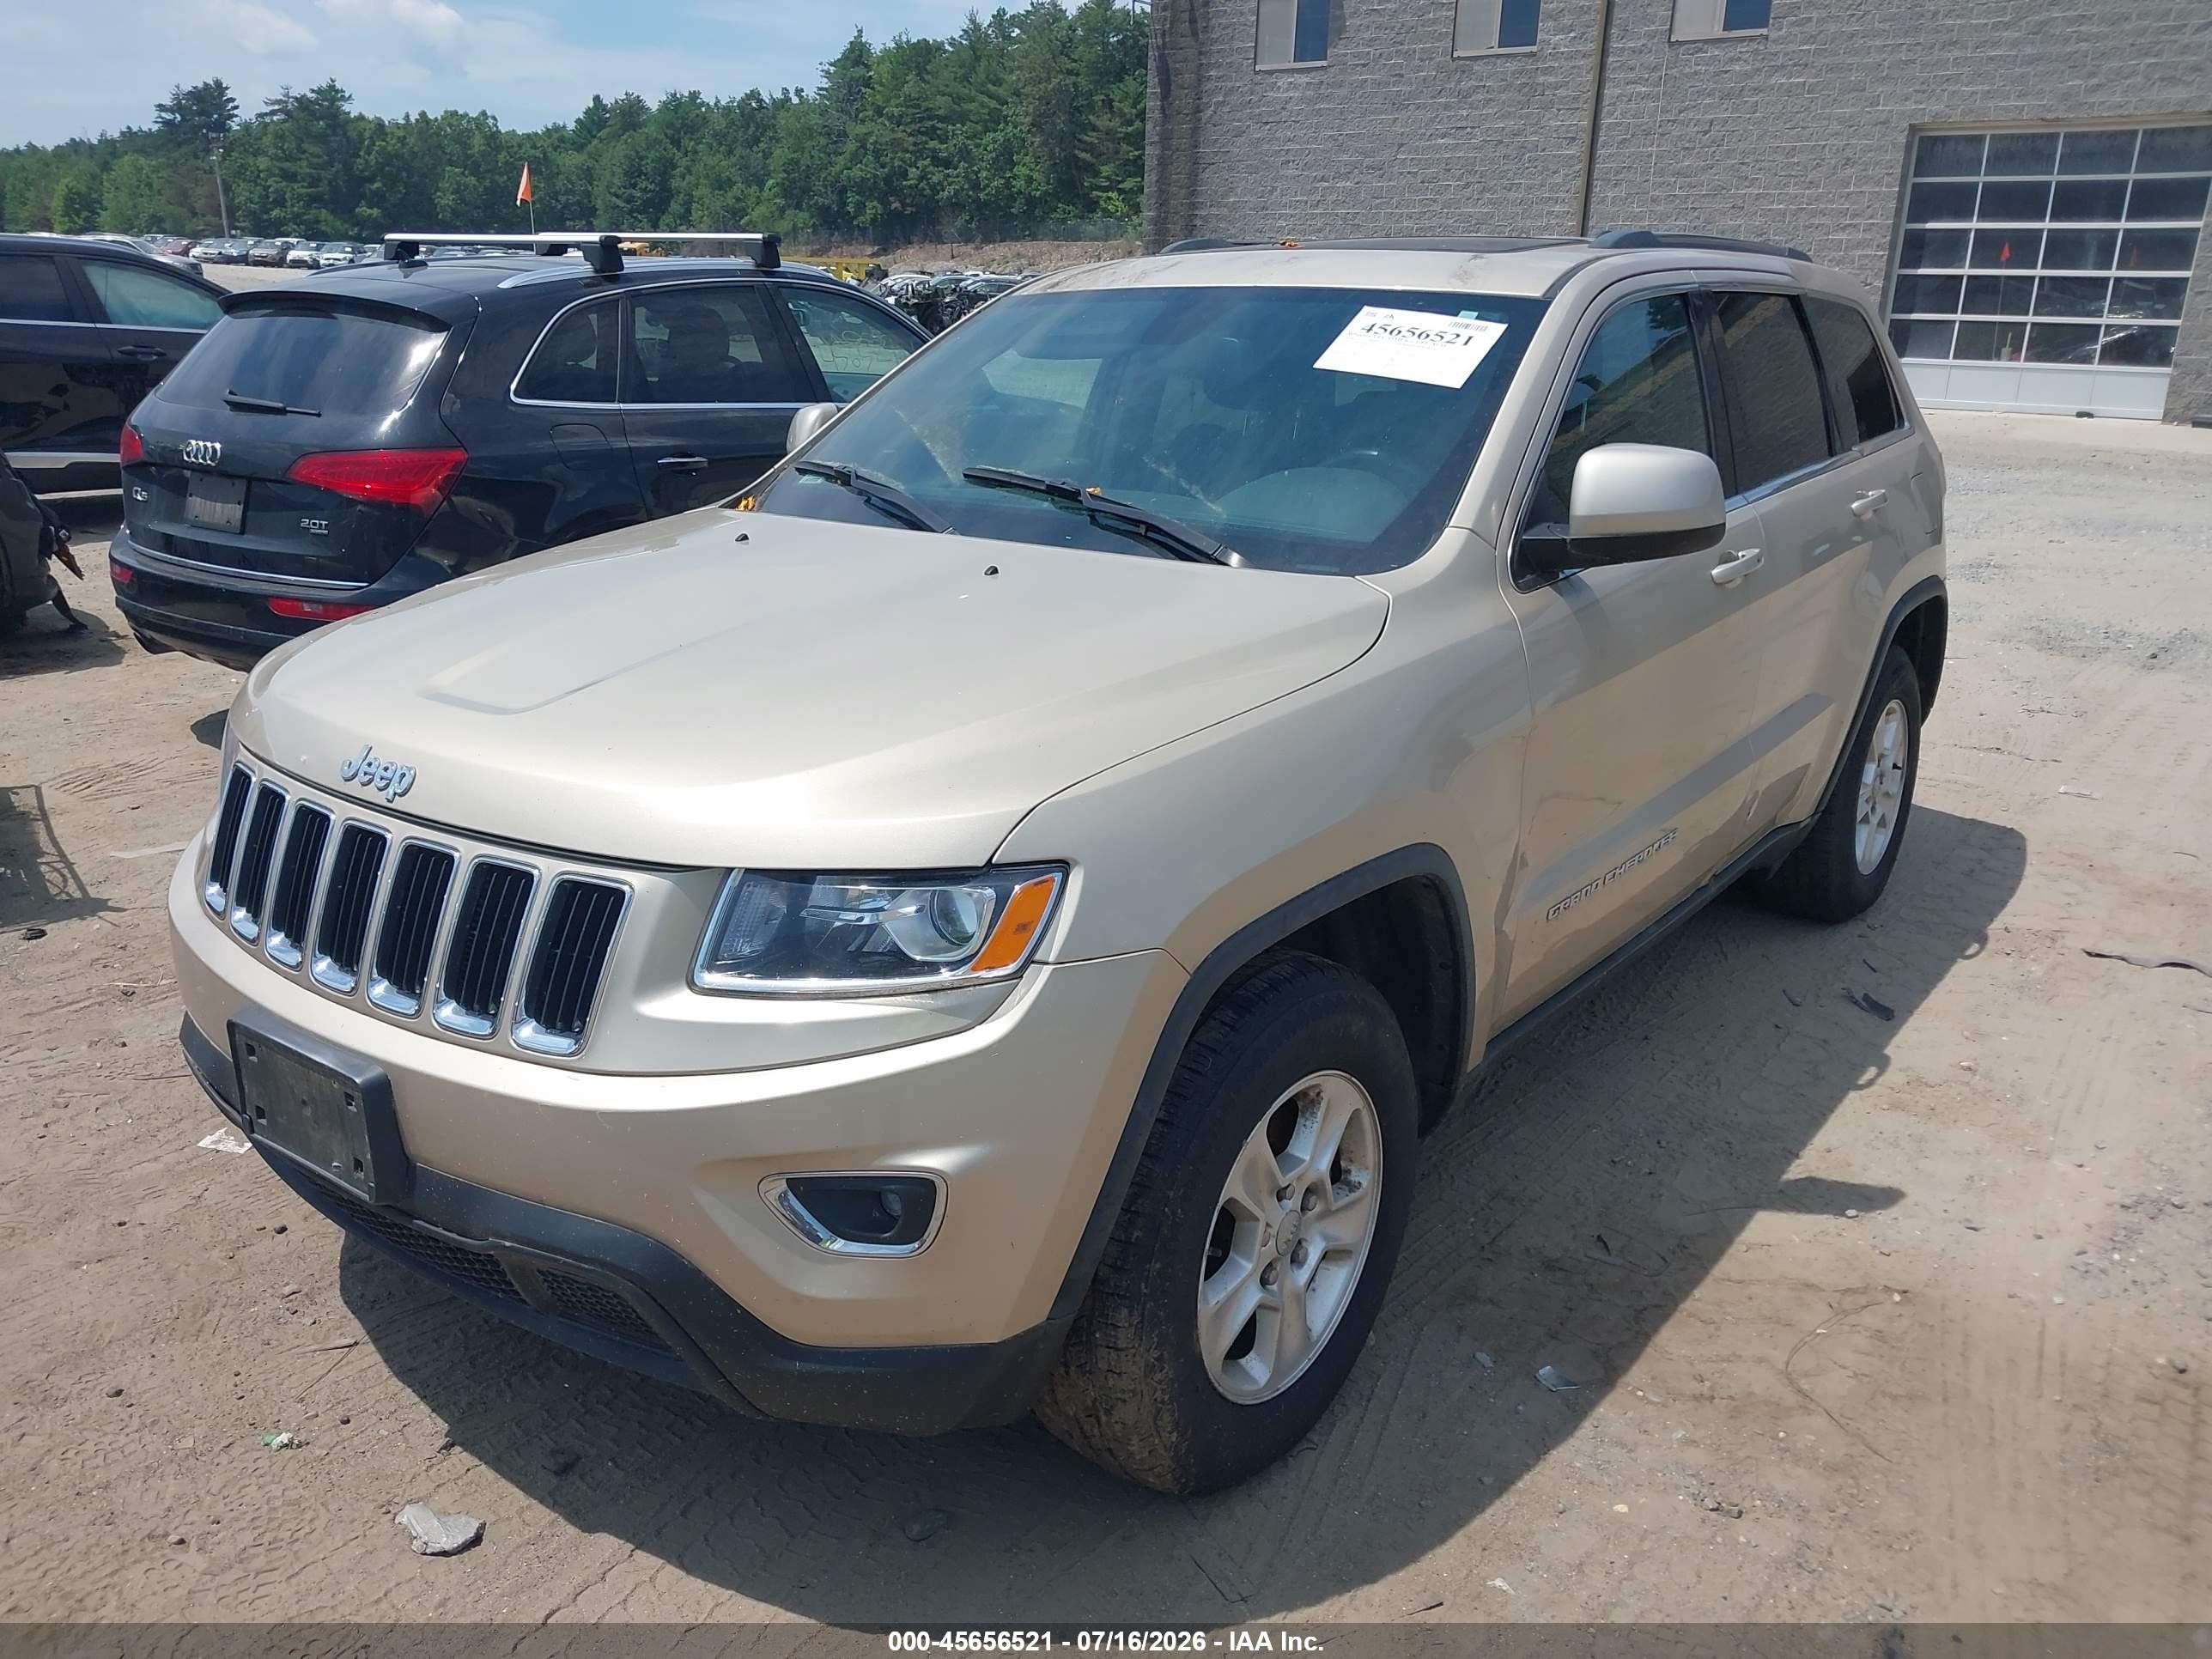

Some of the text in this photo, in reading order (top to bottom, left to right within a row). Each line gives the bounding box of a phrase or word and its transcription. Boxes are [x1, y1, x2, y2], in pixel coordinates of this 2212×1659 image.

[1361, 322, 1475, 347] 45656521
[132, 486, 148, 501] Q5
[340, 743, 416, 804] Jeep
[1546, 827, 1679, 921] GRAND CHEROKEE
